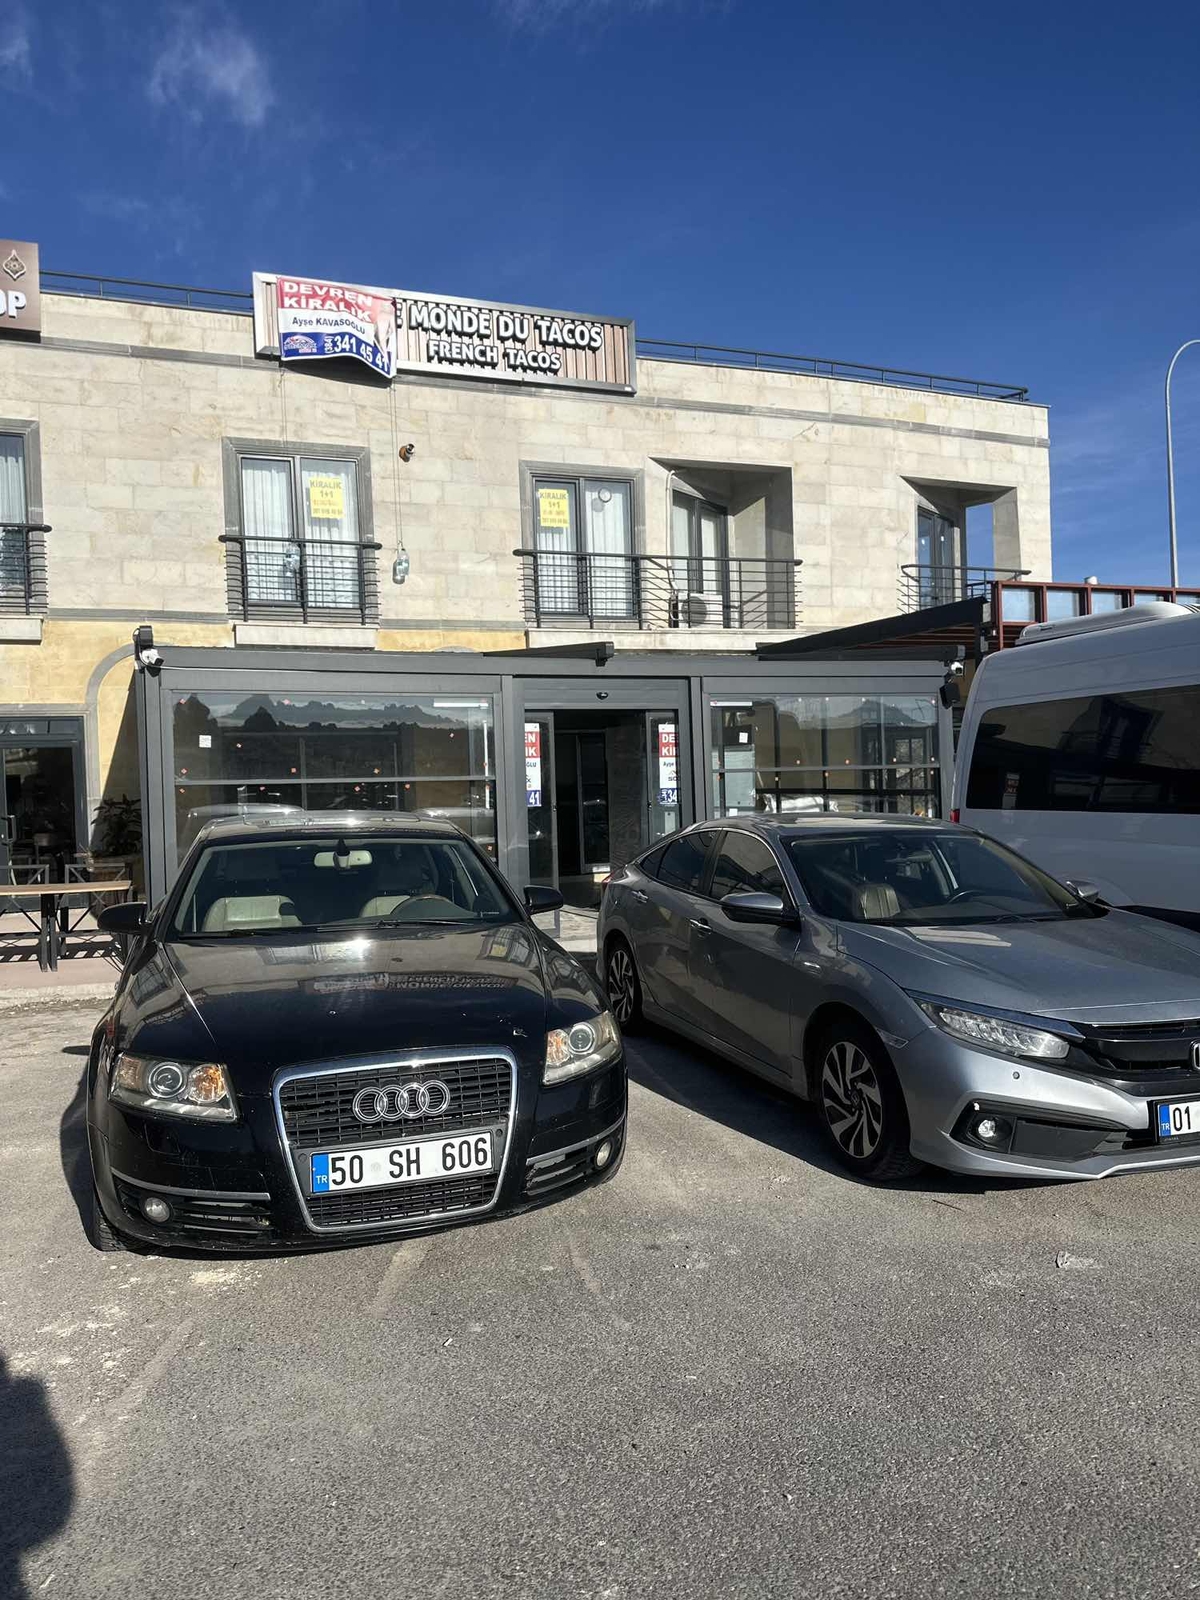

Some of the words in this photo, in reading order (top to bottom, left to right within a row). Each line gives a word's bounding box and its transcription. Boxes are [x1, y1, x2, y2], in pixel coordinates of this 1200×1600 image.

[284, 281, 373, 307] DEVREN
[409, 304, 492, 336] MONDE
[498, 315, 530, 341] DU
[537, 319, 603, 349] TACOS
[334, 334, 357, 353] 341
[360, 343, 373, 363] 45
[375, 352, 388, 372] 41
[427, 340, 498, 364] FRENCH
[505, 348, 561, 371] TACOS
[320, 490, 334, 498] 1+1
[1161, 1123, 1170, 1131] TR
[1172, 1106, 1191, 1132] 01
[316, 1175, 328, 1185] TR
[331, 1154, 364, 1186] 50
[389, 1147, 421, 1179] SH
[442, 1137, 488, 1171] 606
